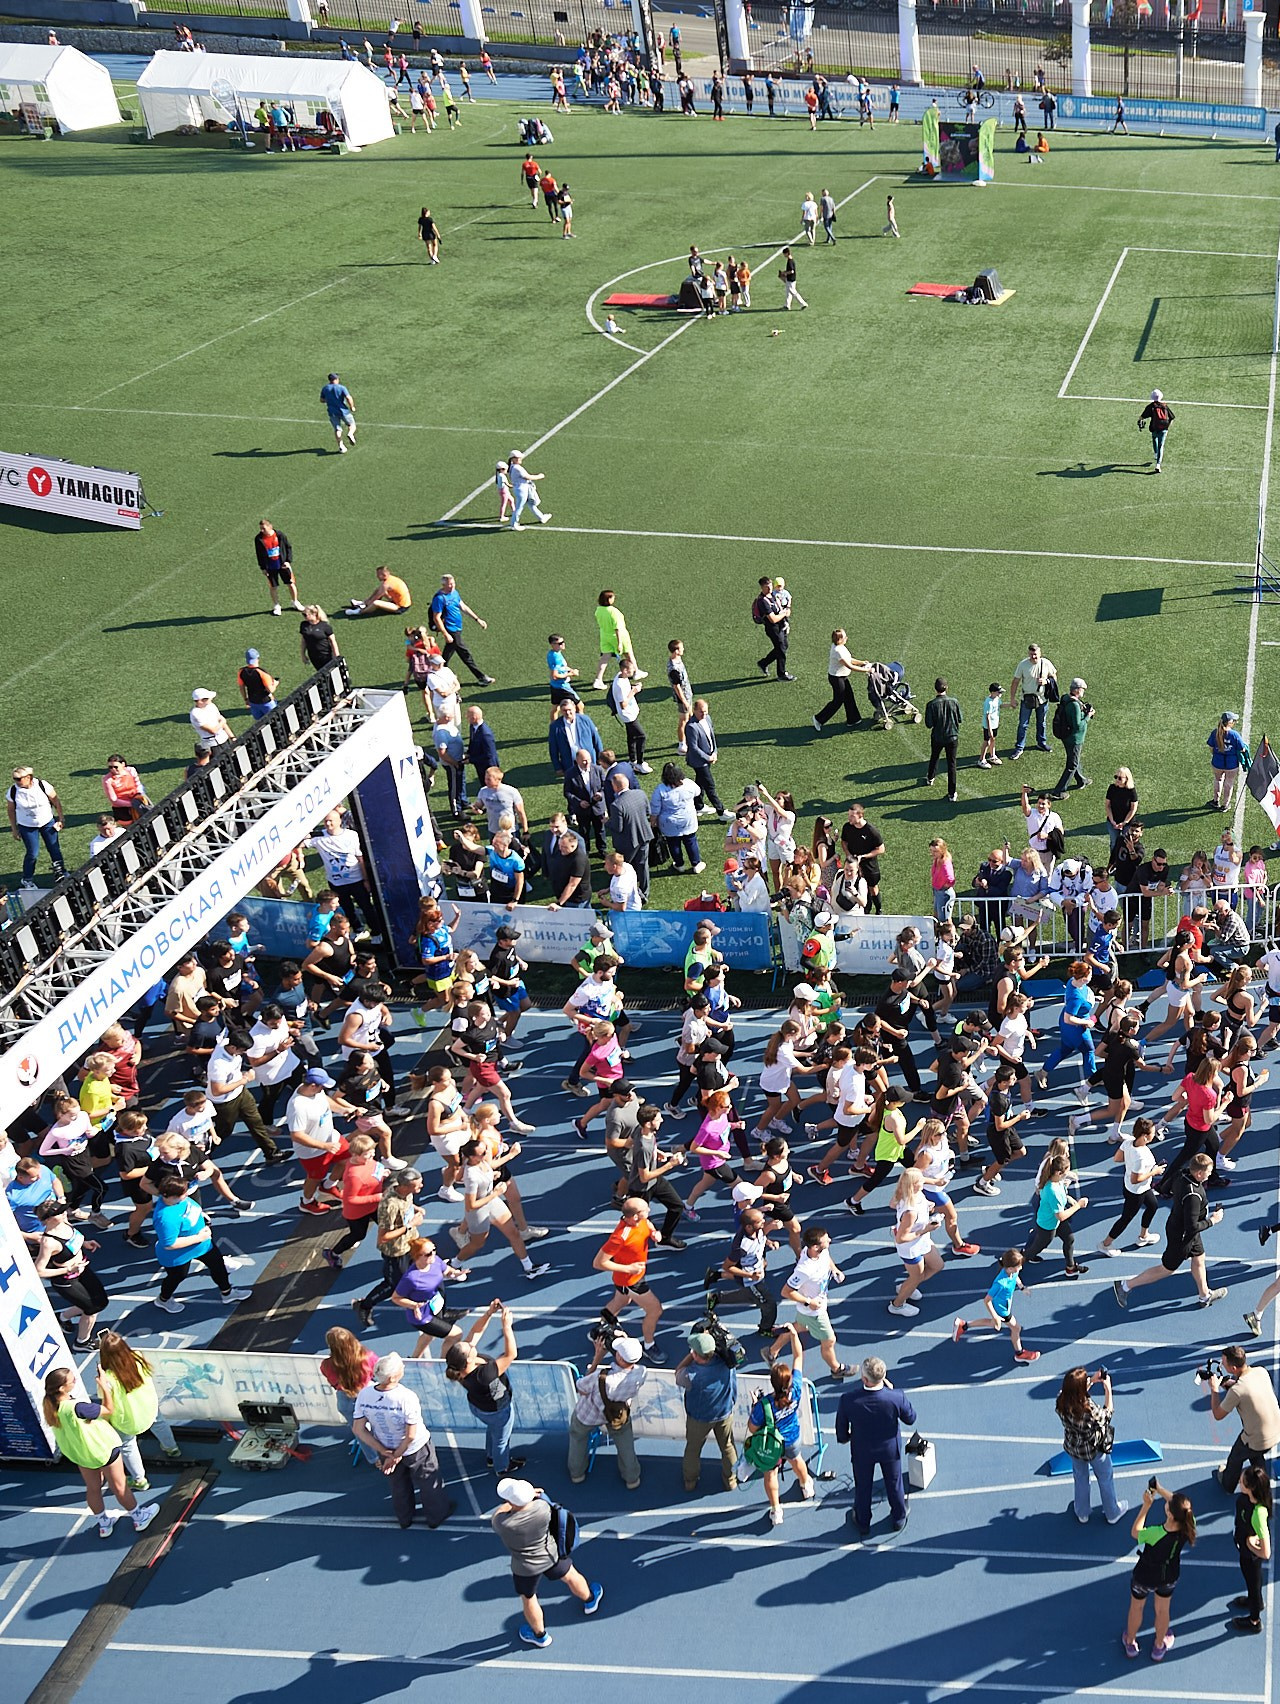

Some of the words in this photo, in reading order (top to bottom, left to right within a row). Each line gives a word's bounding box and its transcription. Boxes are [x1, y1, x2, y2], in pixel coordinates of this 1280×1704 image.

[57, 881, 224, 1055] ДИНАМОВСКАЯ
[229, 827, 282, 886] МИЛЯ
[295, 777, 332, 823] 2024
[859, 939, 930, 950] ДИНО
[235, 1380, 333, 1396] ДИНАМО
